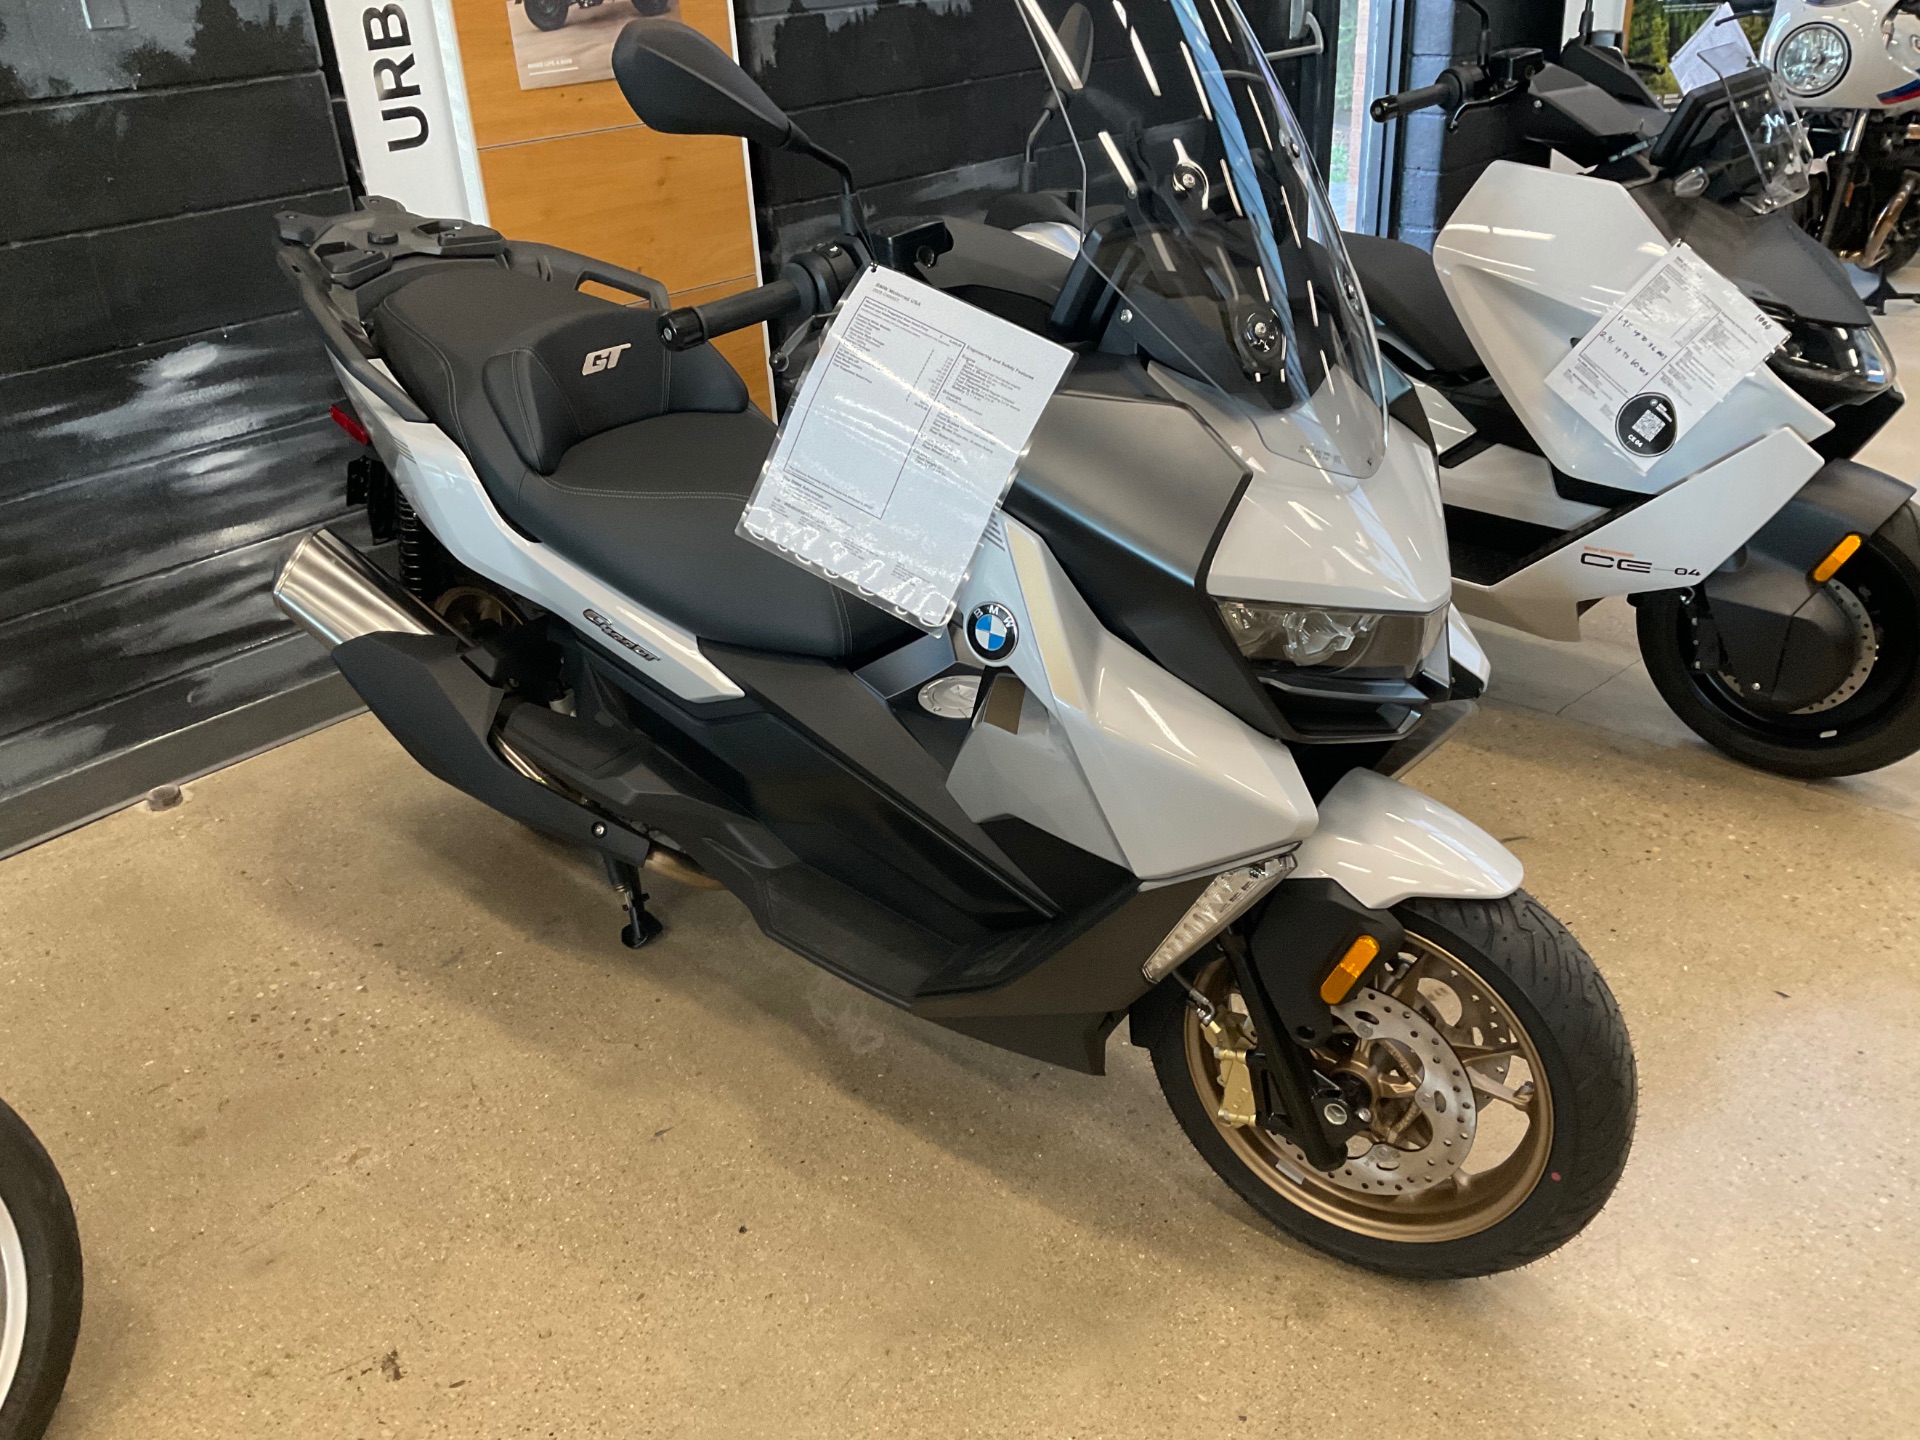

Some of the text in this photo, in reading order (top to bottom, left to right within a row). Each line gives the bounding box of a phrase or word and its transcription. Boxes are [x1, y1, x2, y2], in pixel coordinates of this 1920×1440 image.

[910, 298, 921, 306] USA
[581, 342, 632, 376] GT
[1628, 434, 1644, 448] CE 04
[1580, 552, 1701, 577] CE 04
[973, 604, 1015, 628] BMW
